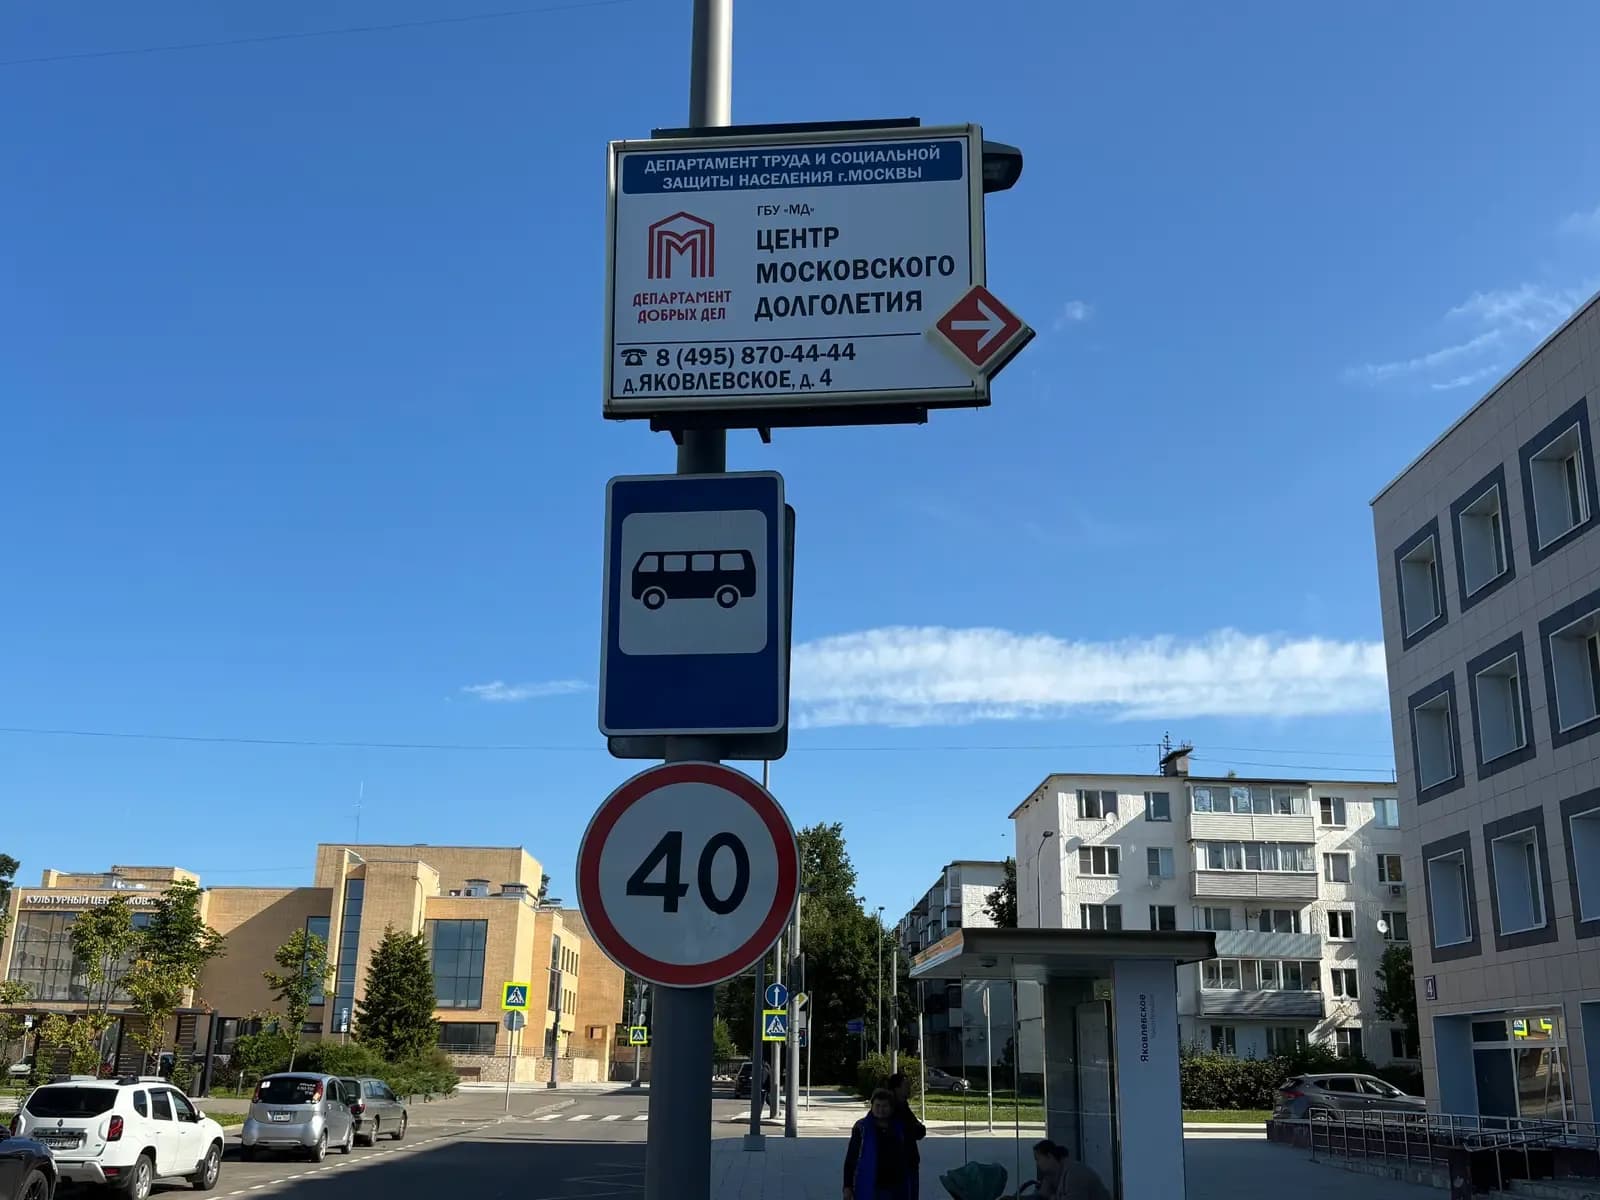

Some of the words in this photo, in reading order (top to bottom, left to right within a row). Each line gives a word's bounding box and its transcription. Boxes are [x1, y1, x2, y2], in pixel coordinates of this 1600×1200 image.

[644, 156, 759, 174] ДЕПАРТАМЕНТ
[762, 154, 811, 170] ТРУДА
[815, 153, 826, 165] И
[830, 144, 940, 166] СОЦИАЛЬНОЙ
[662, 175, 734, 190] ЗАЩИТЫ
[739, 171, 833, 187] НАСЕЛЕНИЯ
[838, 166, 922, 183] г.МОСКВЫ
[757, 205, 780, 216] ГБУ
[756, 226, 840, 253] ЦЕНТР
[756, 255, 955, 284] МОСКОВСКОГО
[632, 290, 732, 307] ДЕПАРТАМЕНТ
[754, 290, 922, 322] ДОЛГОЛЕТИЯ
[637, 308, 697, 324] ДОБРЫХ
[701, 307, 726, 322] ДЕЛ
[656, 349, 670, 367] 8
[676, 347, 735, 370] (495)
[741, 343, 856, 365] 870-44-44
[819, 368, 833, 387] 4
[626, 831, 750, 915] 40
[25, 894, 89, 905] КУЛЬТУРНЫЙ
[1427, 979, 1433, 997] 4
[1139, 993, 1149, 1062] Яковлевское
